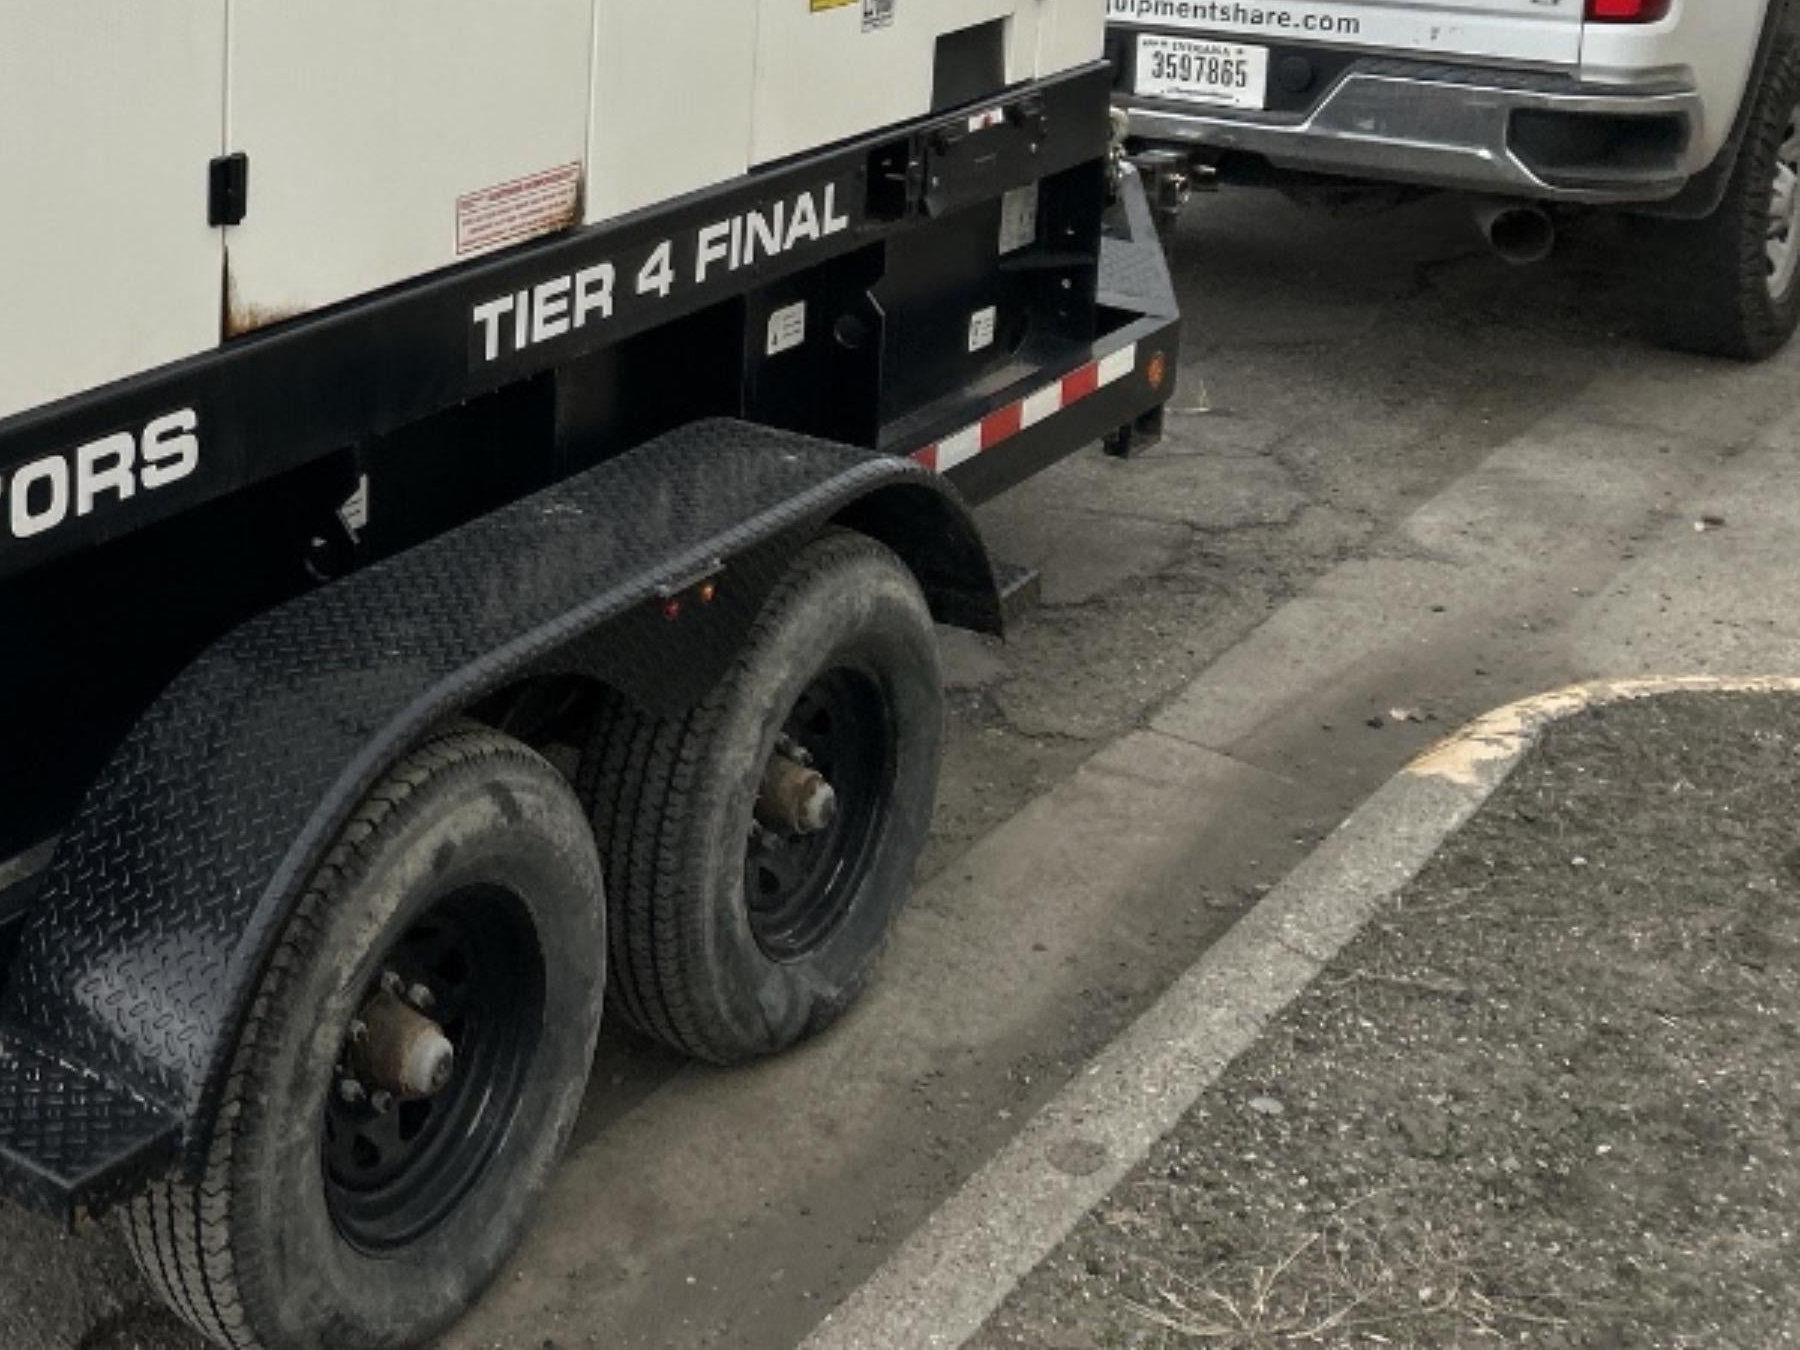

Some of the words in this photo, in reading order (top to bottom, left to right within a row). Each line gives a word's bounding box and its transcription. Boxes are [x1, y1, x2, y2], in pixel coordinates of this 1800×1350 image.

[1152, 50, 1247, 88] 3597865
[473, 262, 617, 362] TIER
[635, 239, 676, 298] 4
[695, 182, 849, 283] FINAL
